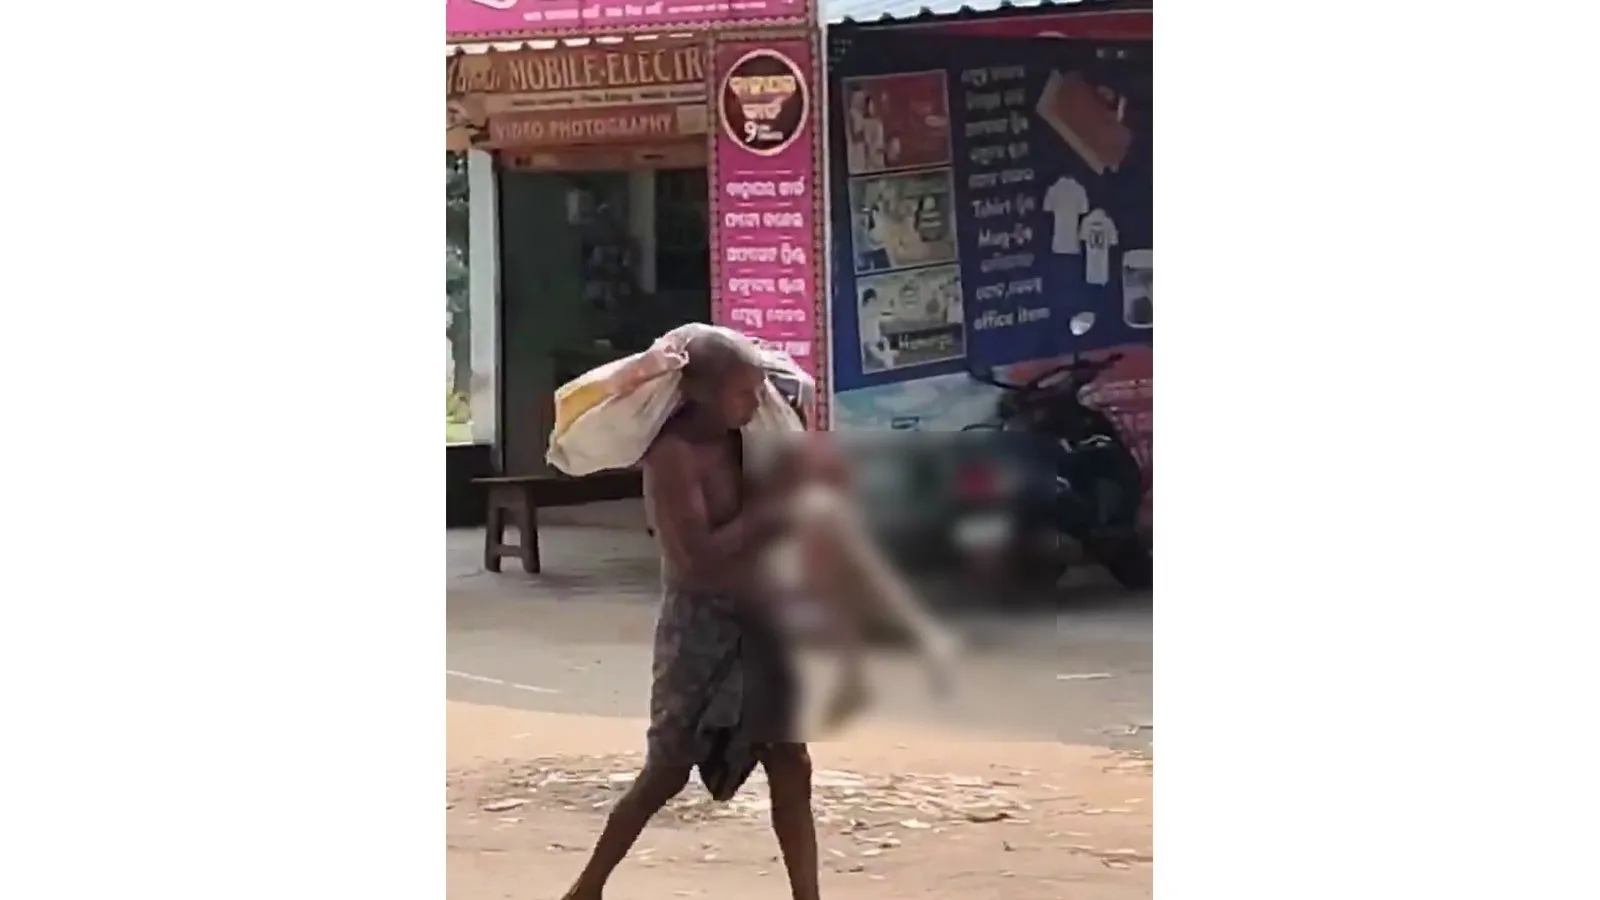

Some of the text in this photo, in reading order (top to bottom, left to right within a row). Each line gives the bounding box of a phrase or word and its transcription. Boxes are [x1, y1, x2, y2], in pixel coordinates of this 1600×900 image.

[496, 114, 672, 141] VIDEO PHOTOGRAPHY
[744, 121, 757, 142] 9
[973, 310, 1014, 331] office
